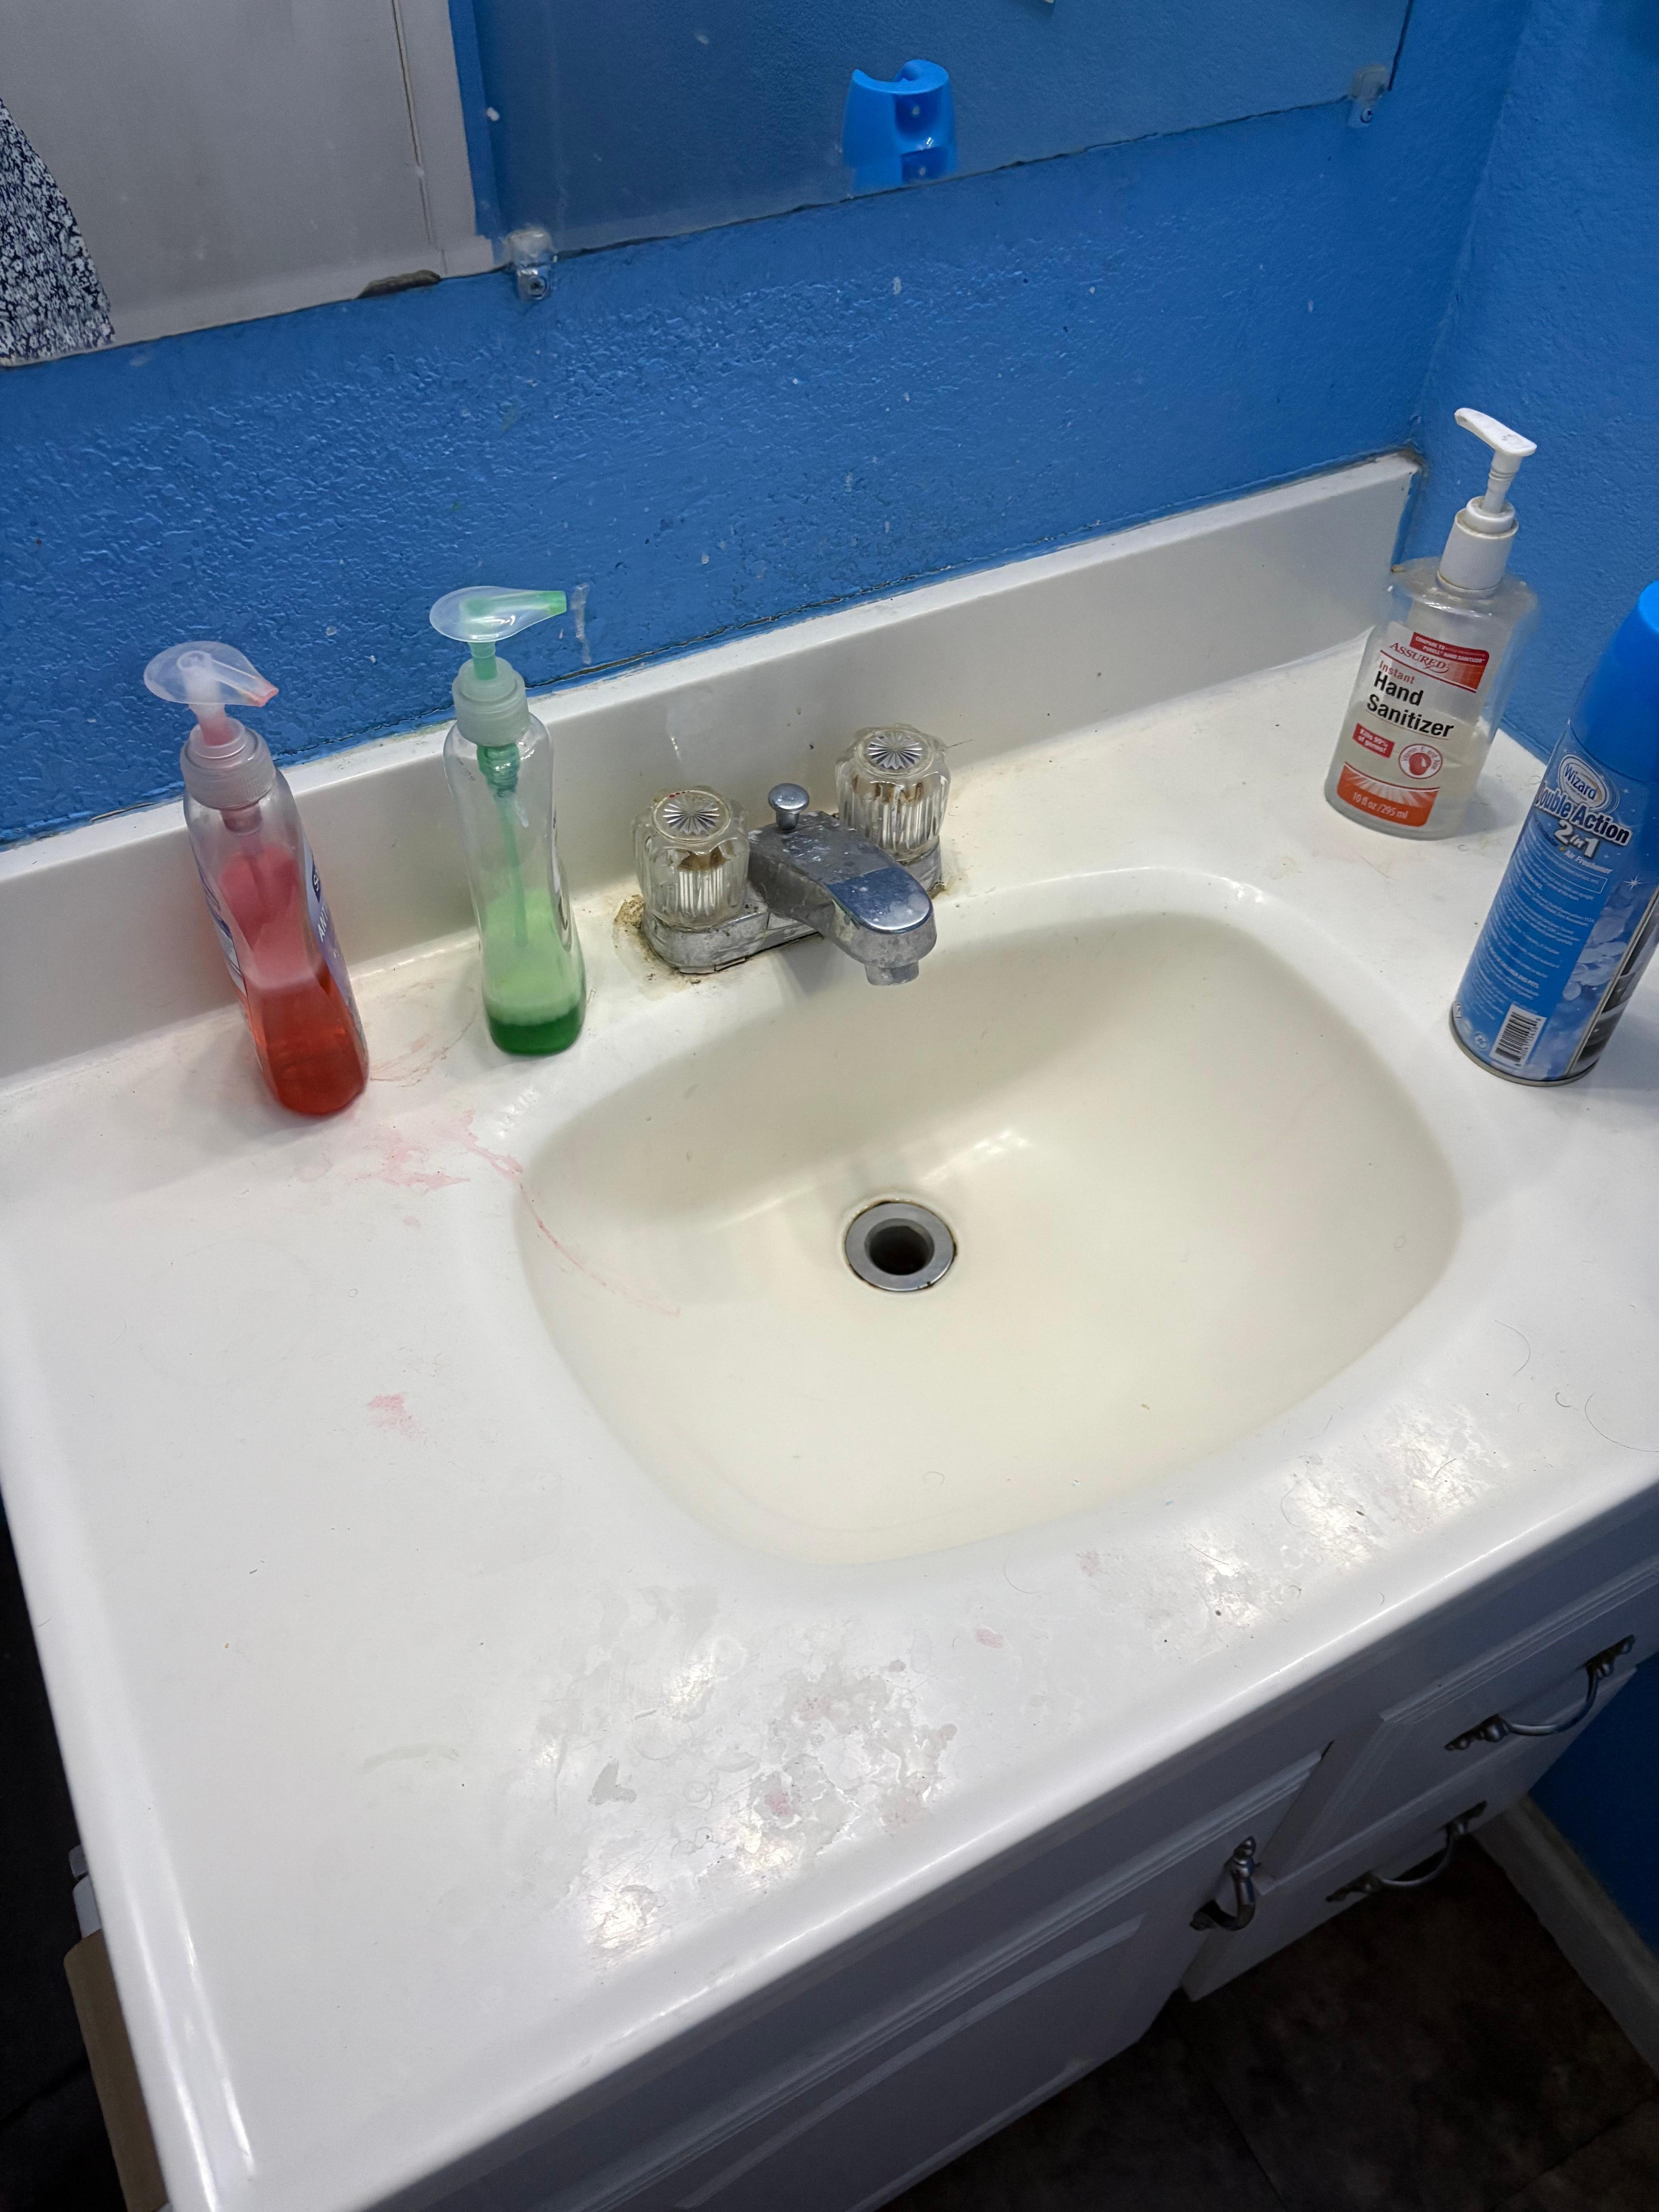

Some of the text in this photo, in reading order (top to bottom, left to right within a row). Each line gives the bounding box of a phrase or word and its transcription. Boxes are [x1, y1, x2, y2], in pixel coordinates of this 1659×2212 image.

[1379, 661, 1415, 684] Instant
[1389, 642, 1447, 671] ASSURED
[1374, 671, 1424, 706] Hand
[1367, 694, 1454, 737] Sanitizer
[1353, 792, 1361, 802] 10
[1368, 802, 1377, 810] oz
[1571, 805, 1630, 843] Action
